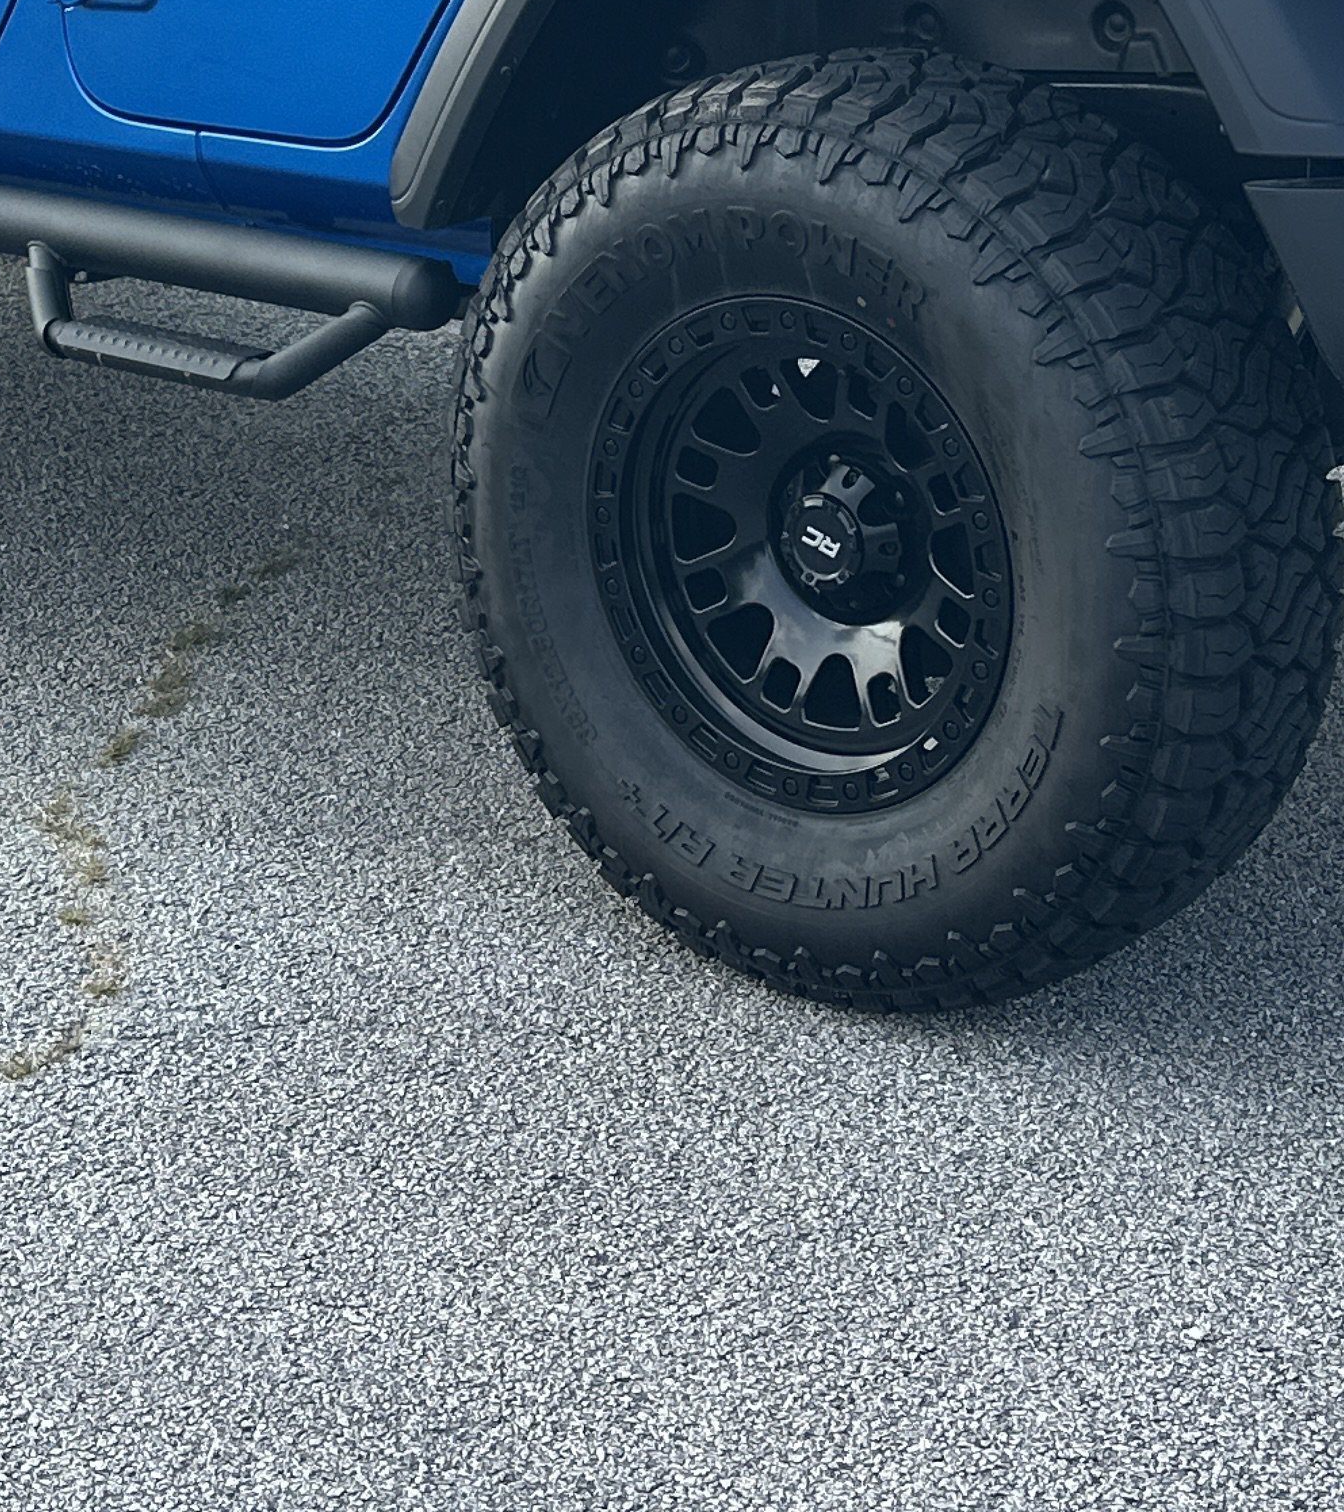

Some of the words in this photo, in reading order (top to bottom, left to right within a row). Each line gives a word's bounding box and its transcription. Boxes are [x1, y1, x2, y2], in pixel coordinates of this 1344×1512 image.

[545, 207, 720, 339] VENOM
[724, 205, 926, 320] POWER
[800, 525, 842, 559] RC
[952, 702, 1065, 876] TERRA
[728, 853, 940, 910] HUNTER
